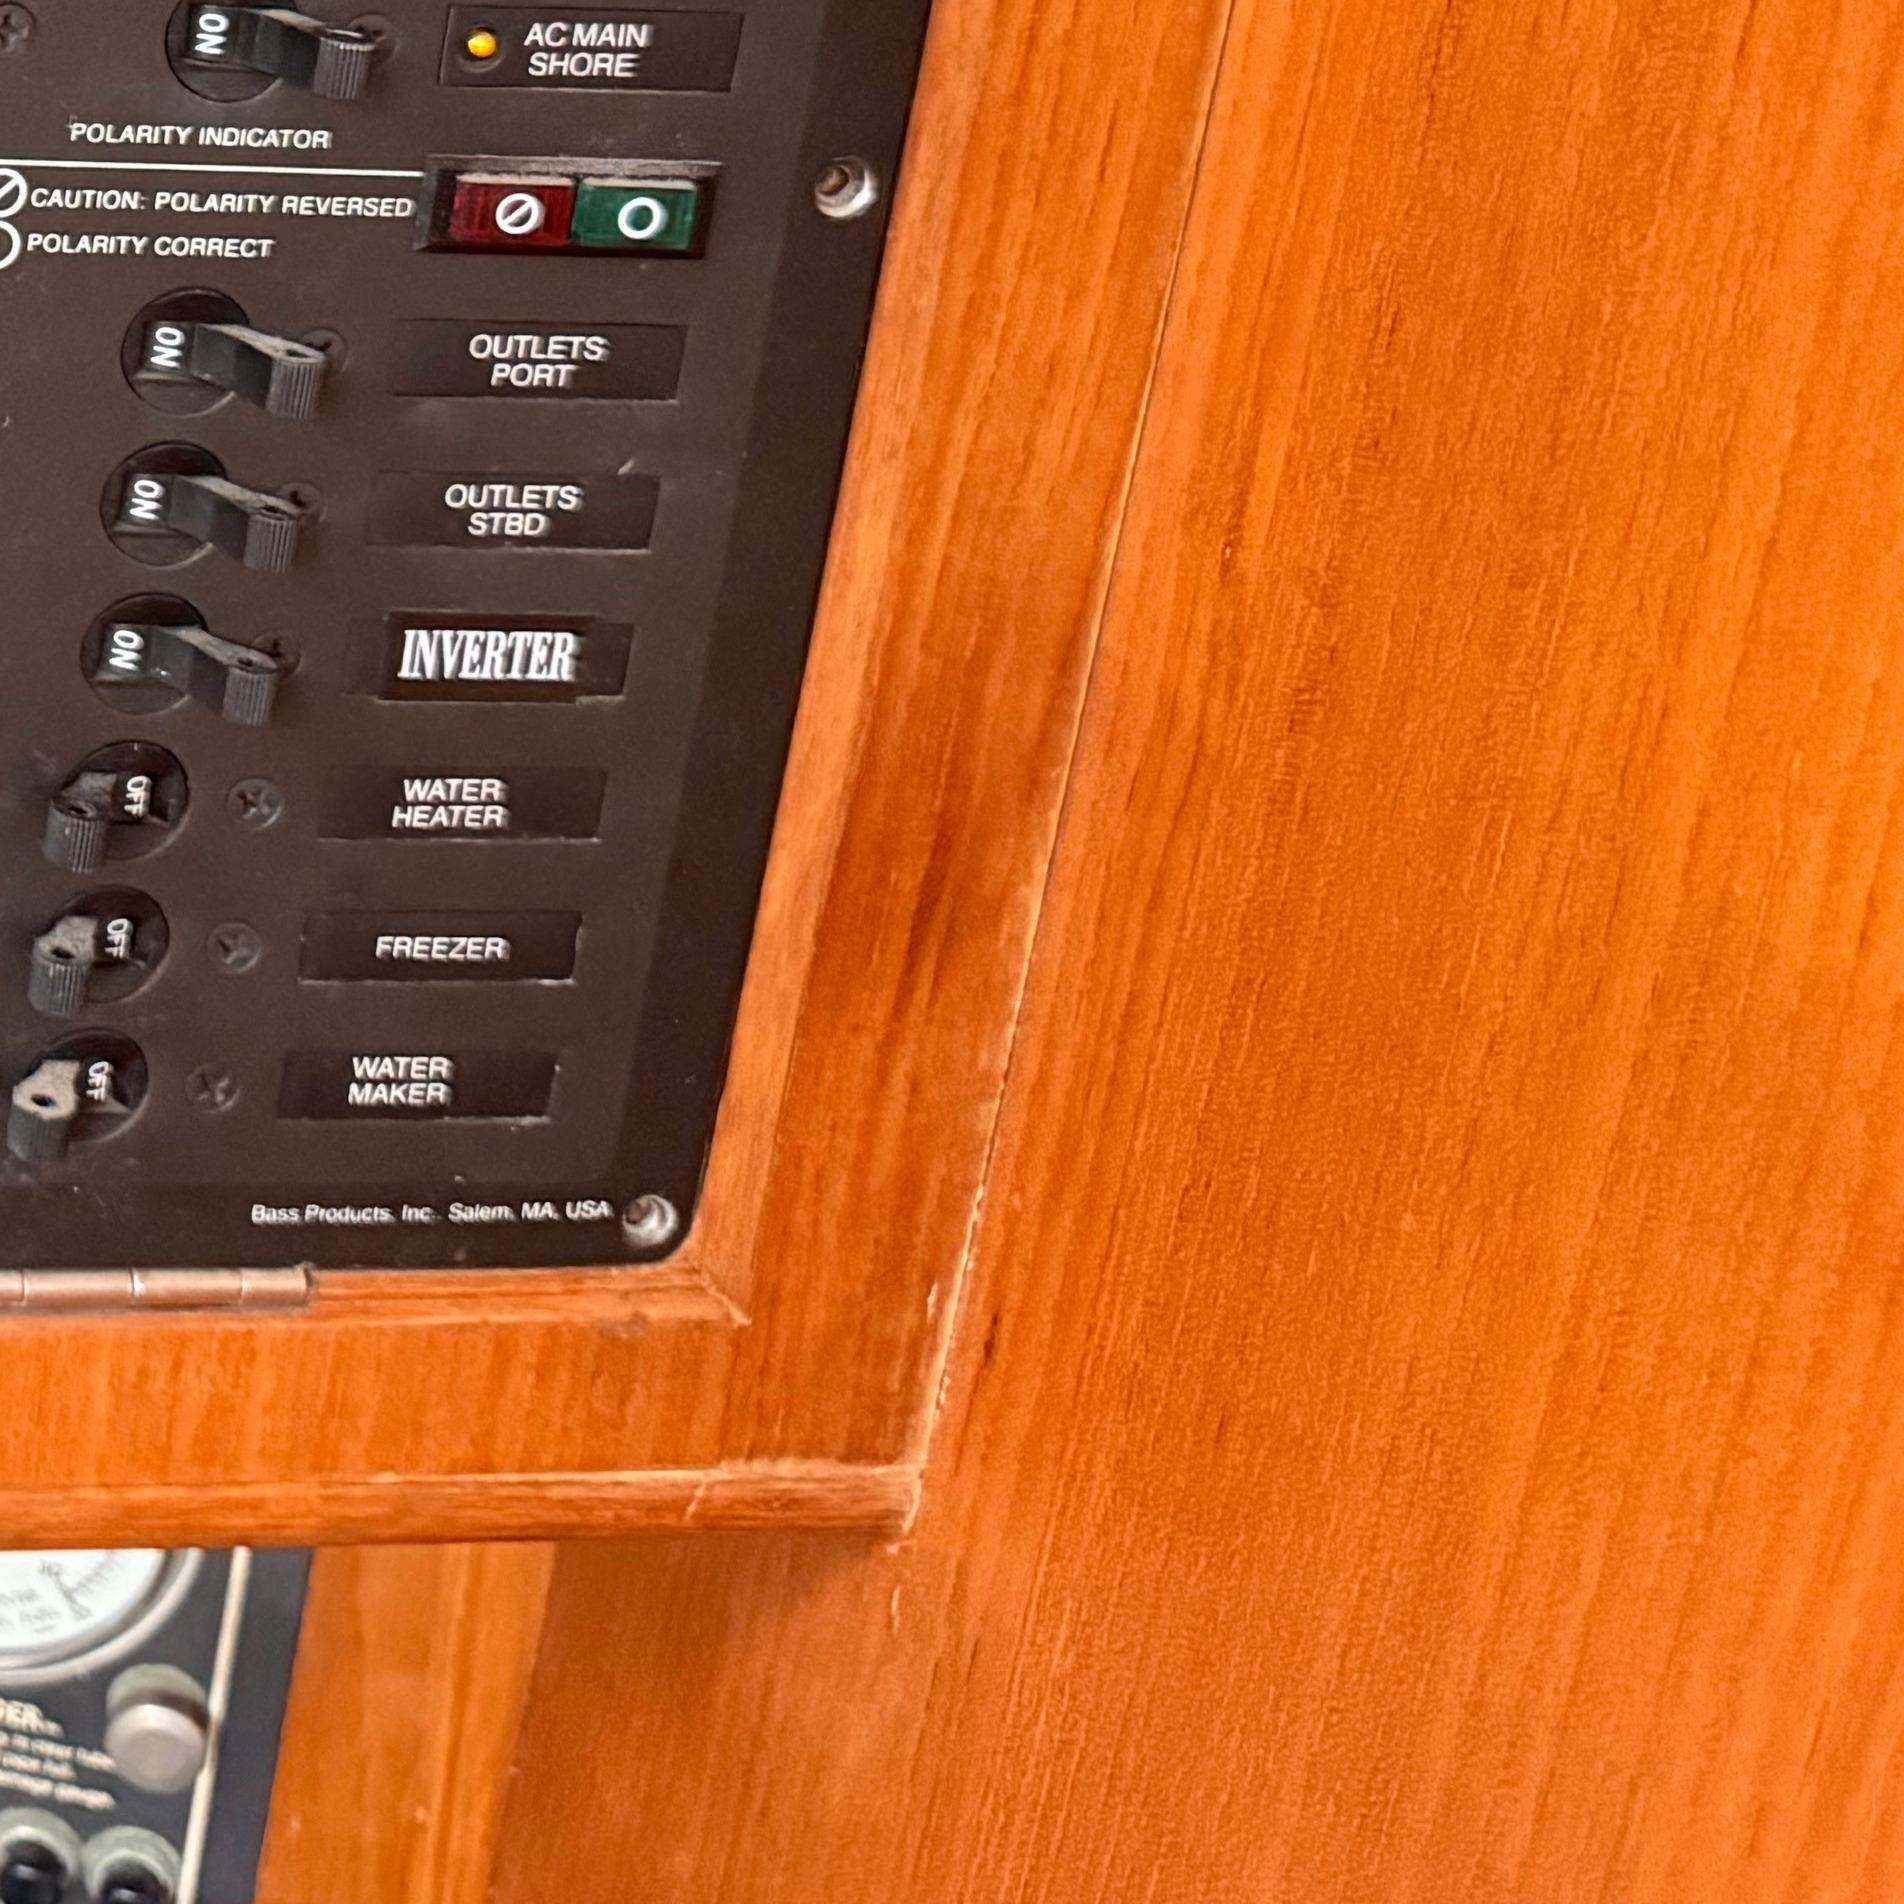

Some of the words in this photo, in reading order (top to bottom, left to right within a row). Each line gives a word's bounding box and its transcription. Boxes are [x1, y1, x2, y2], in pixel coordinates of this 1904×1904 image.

[196, 12, 230, 56] ON
[524, 22, 571, 49] AC
[572, 23, 651, 48] MAIN
[527, 51, 637, 78] SHORE
[70, 121, 193, 147] POLARITY
[199, 126, 331, 150] INDICATOR
[31, 188, 147, 213] CAUTION:
[153, 192, 278, 217] POLARITY
[283, 195, 413, 219] REVERSED
[26, 232, 148, 258] POLARITY
[153, 235, 275, 259] CORRECT
[150, 326, 183, 368] ON
[469, 335, 610, 362] OUTLETS
[491, 364, 575, 388] PORT
[130, 479, 162, 521] ON
[444, 485, 582, 511] OUTLETS
[468, 512, 551, 537] STBD
[110, 630, 141, 671] ON
[399, 630, 579, 682] INVERTER
[403, 778, 509, 804] WATER
[392, 804, 509, 830] HEATER
[376, 936, 510, 961] FREEZER
[352, 1056, 455, 1081] WATER
[347, 1081, 453, 1106] MAKER
[250, 1204, 301, 1224] Bass
